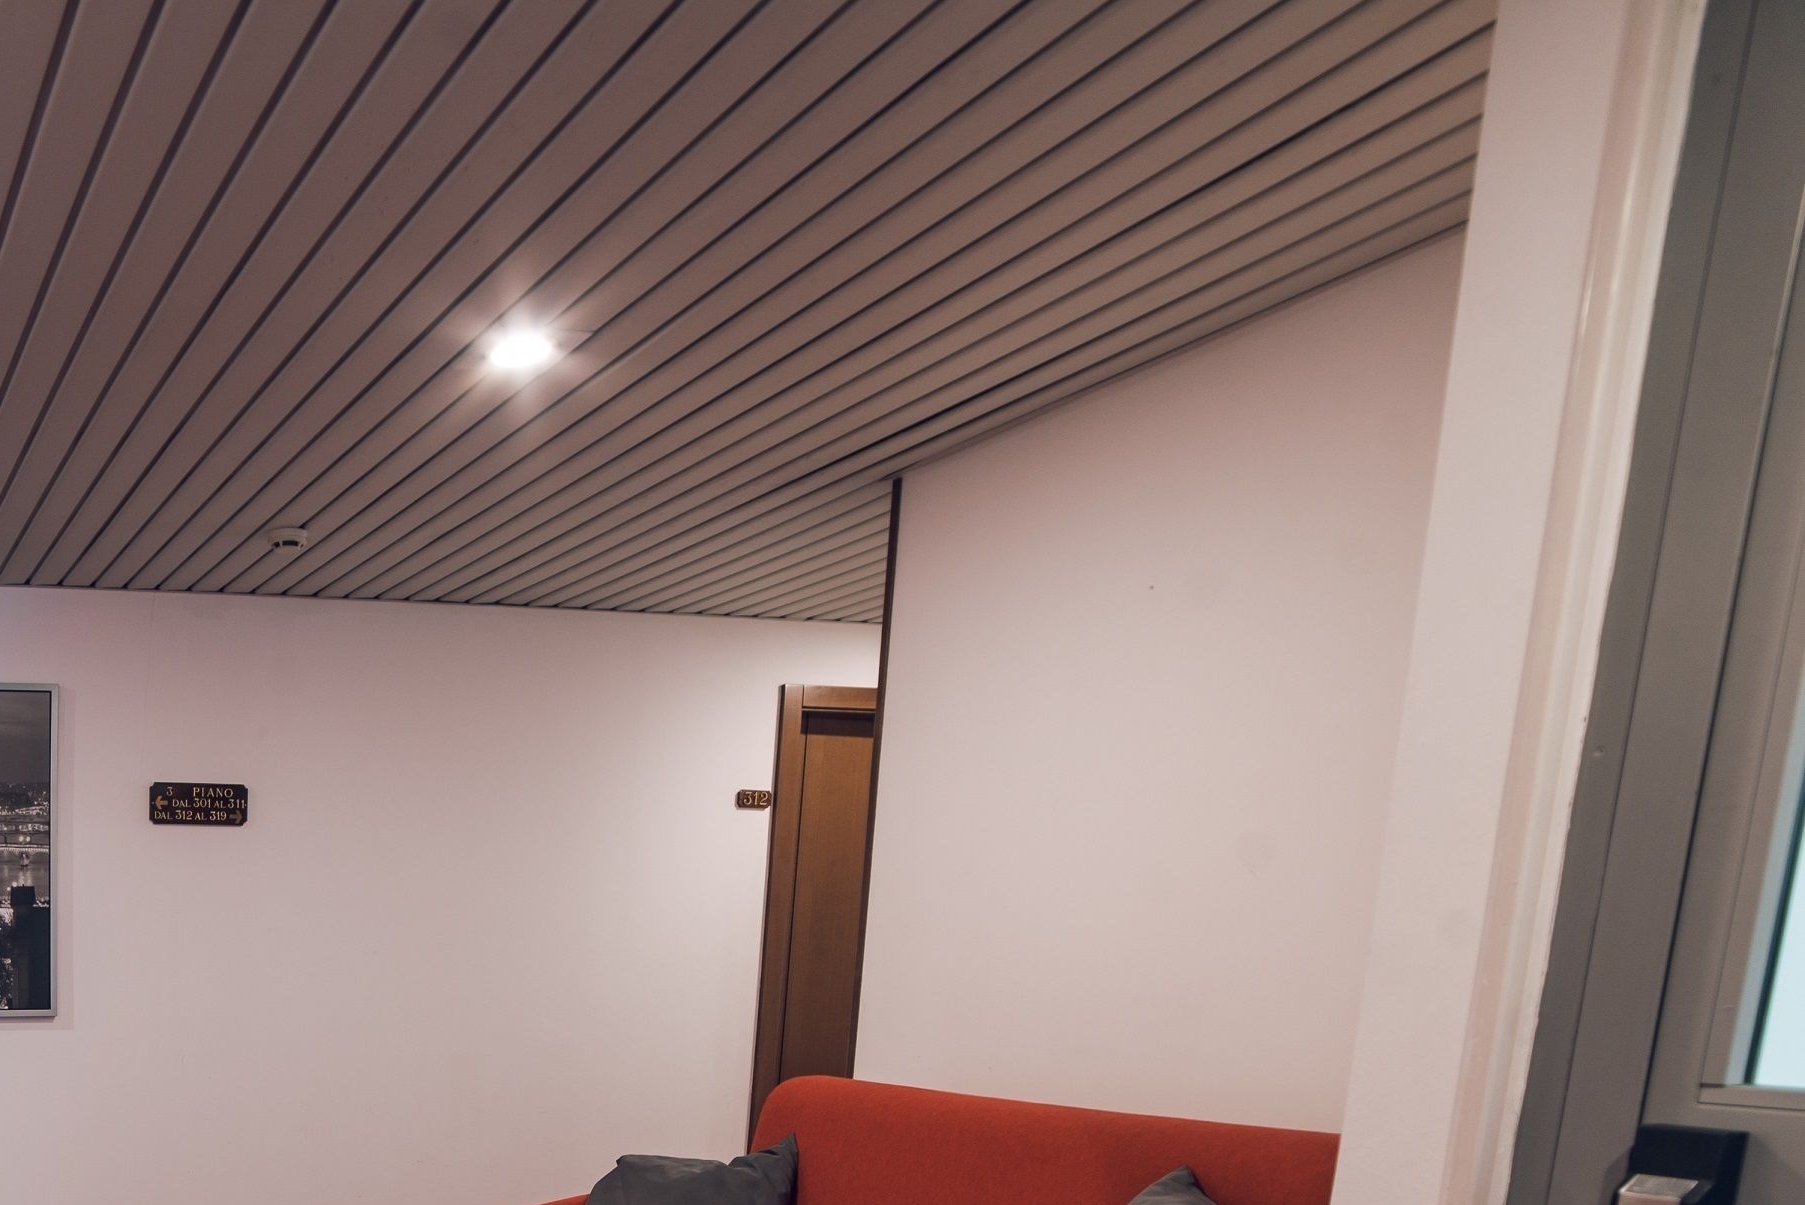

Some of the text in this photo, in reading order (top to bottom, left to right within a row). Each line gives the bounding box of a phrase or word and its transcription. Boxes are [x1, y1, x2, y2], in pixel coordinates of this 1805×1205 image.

[166, 786, 234, 798] 3 PIANO
[172, 798, 245, 809] DAL 301 AL 311
[743, 791, 769, 805] 312
[154, 810, 227, 821] DAL 312 AL 319
